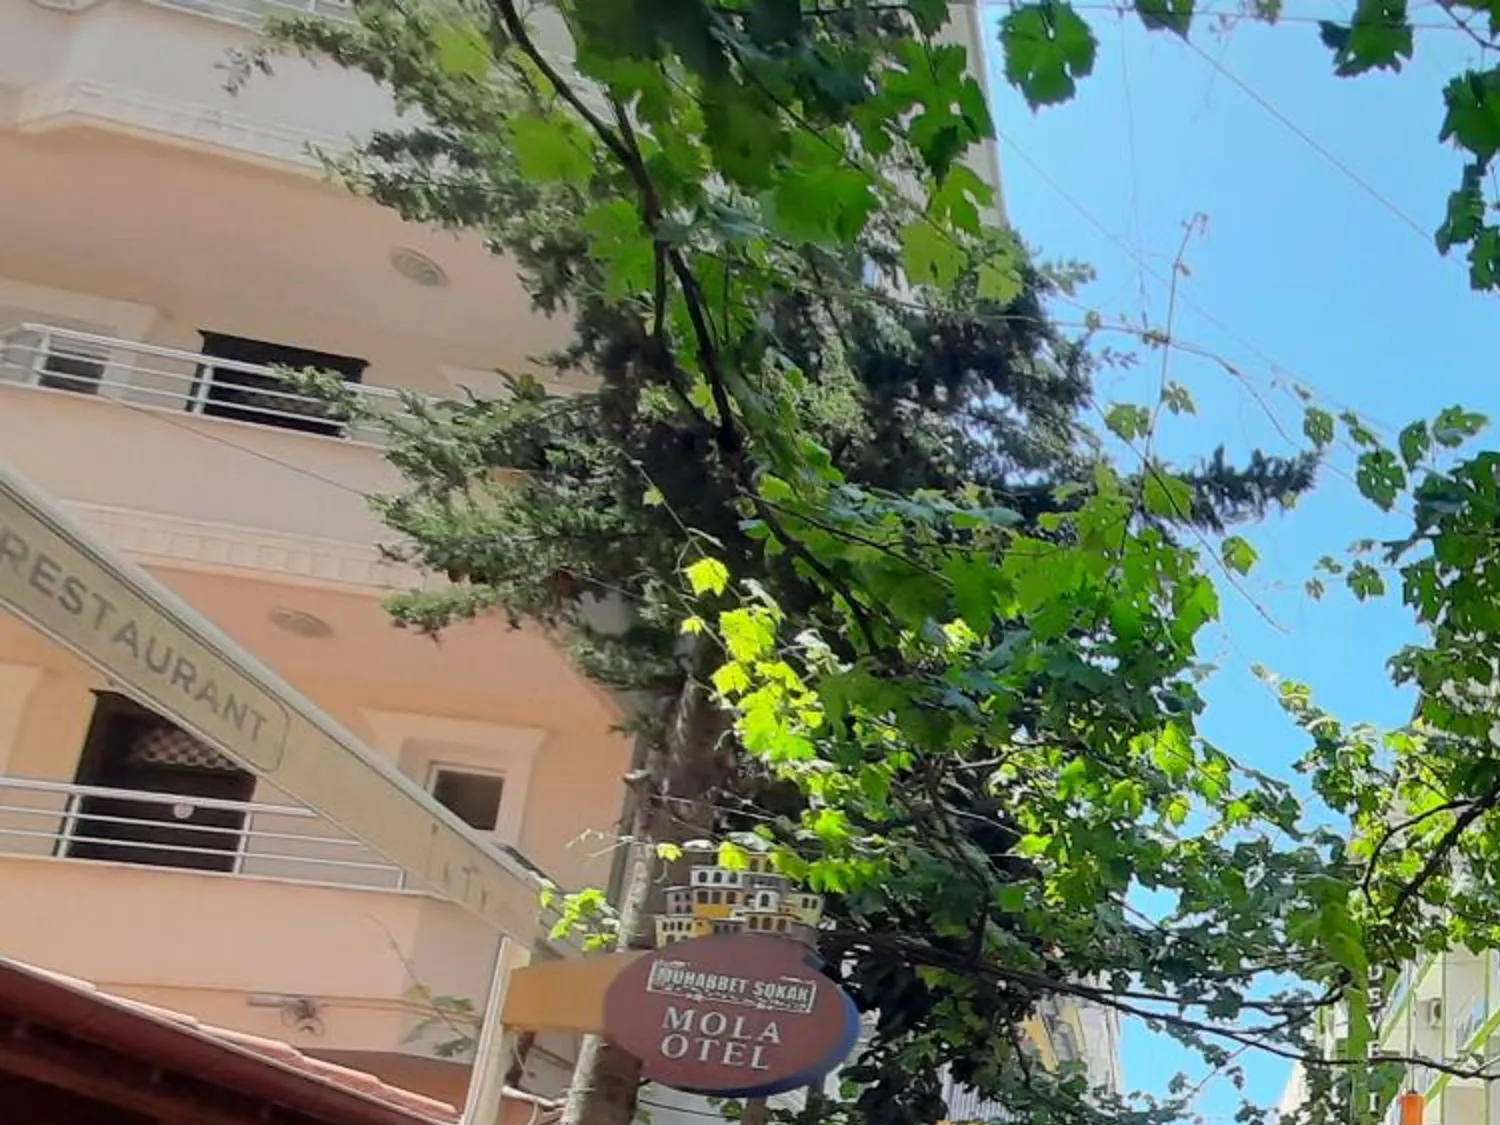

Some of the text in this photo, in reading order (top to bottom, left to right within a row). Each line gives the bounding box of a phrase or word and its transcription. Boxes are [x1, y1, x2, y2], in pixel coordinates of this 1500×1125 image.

[0, 524, 269, 742] RESTAURANT
[656, 965, 748, 994] MUHABBET
[660, 1005, 782, 1044] MOLA
[660, 1033, 770, 1071] OTEL
